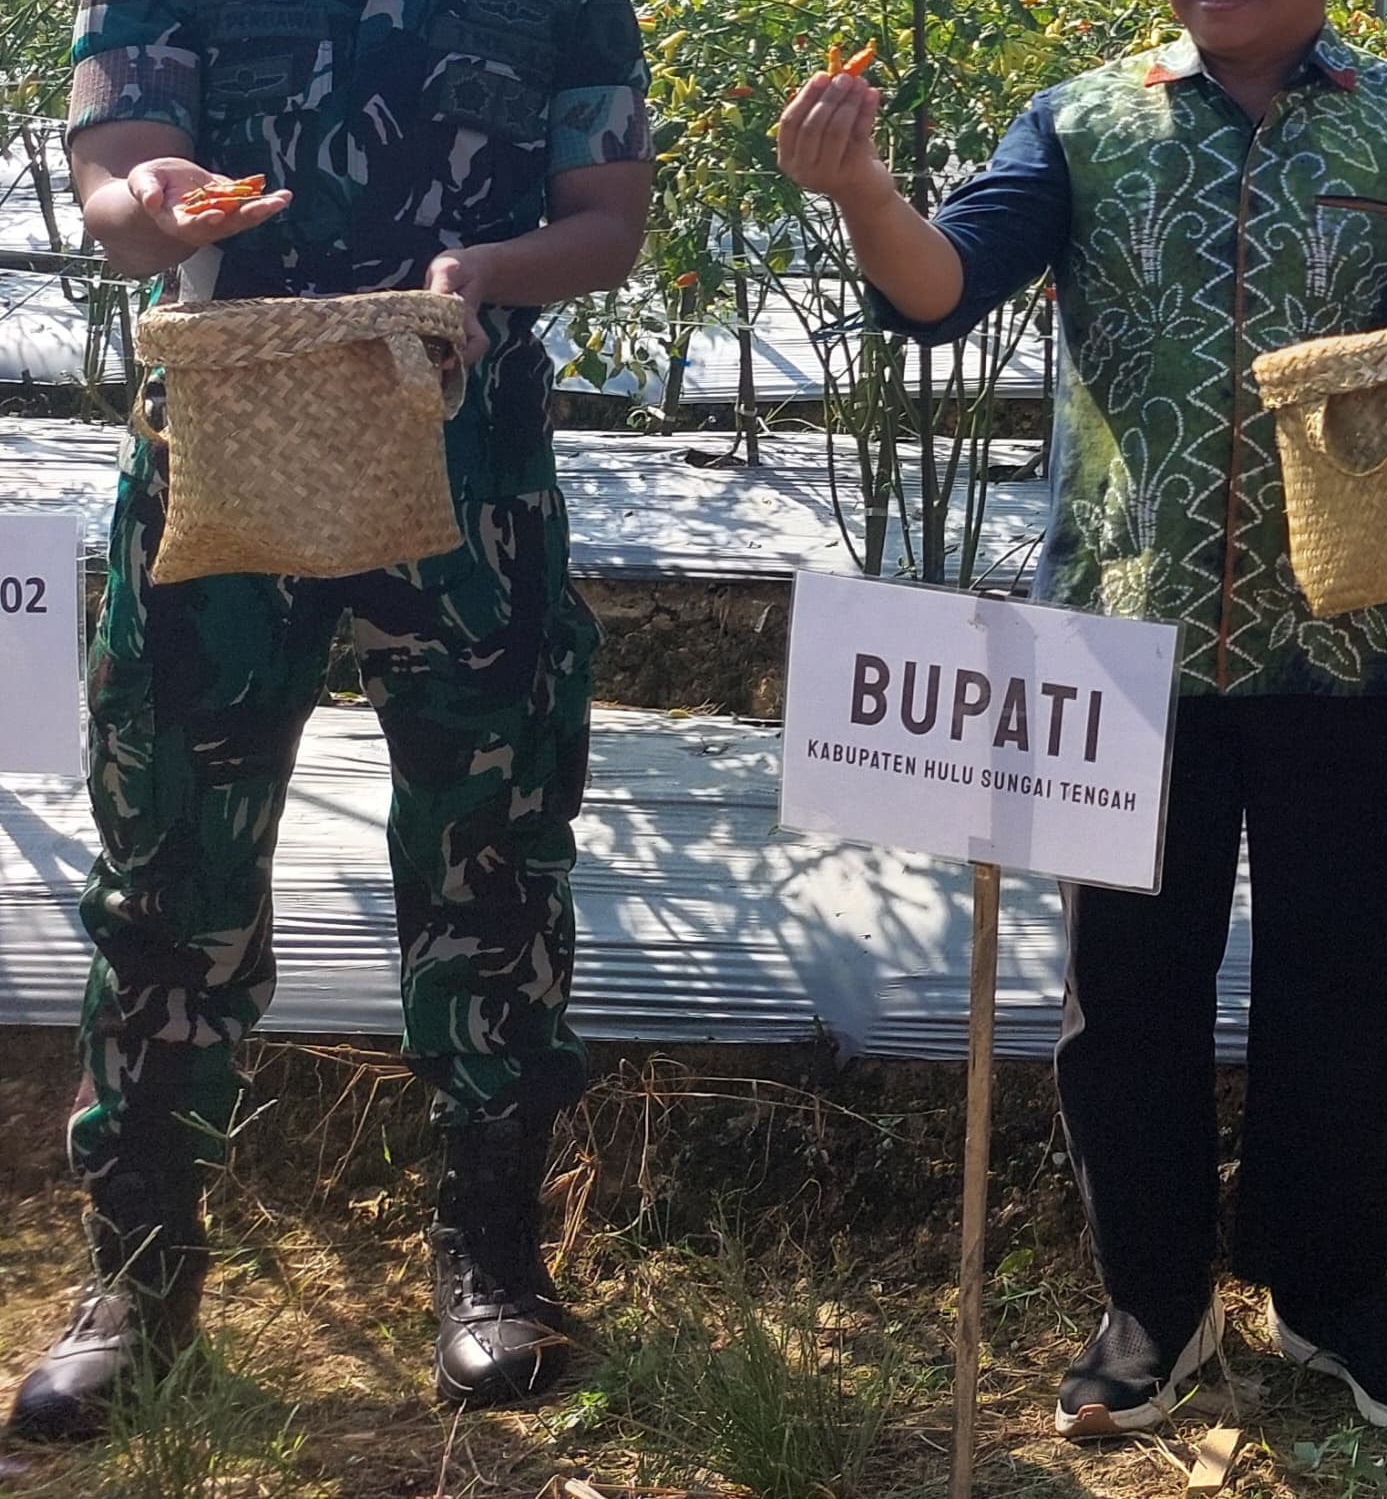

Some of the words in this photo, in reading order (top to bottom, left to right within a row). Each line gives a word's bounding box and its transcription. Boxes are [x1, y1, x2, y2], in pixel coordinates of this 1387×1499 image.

[850, 653, 1103, 763] BUPATI
[807, 739, 916, 777] KABUPATEN
[924, 759, 973, 785] HULU
[980, 769, 1052, 798] SUNGAI
[1060, 782, 1137, 811] TENGAH
